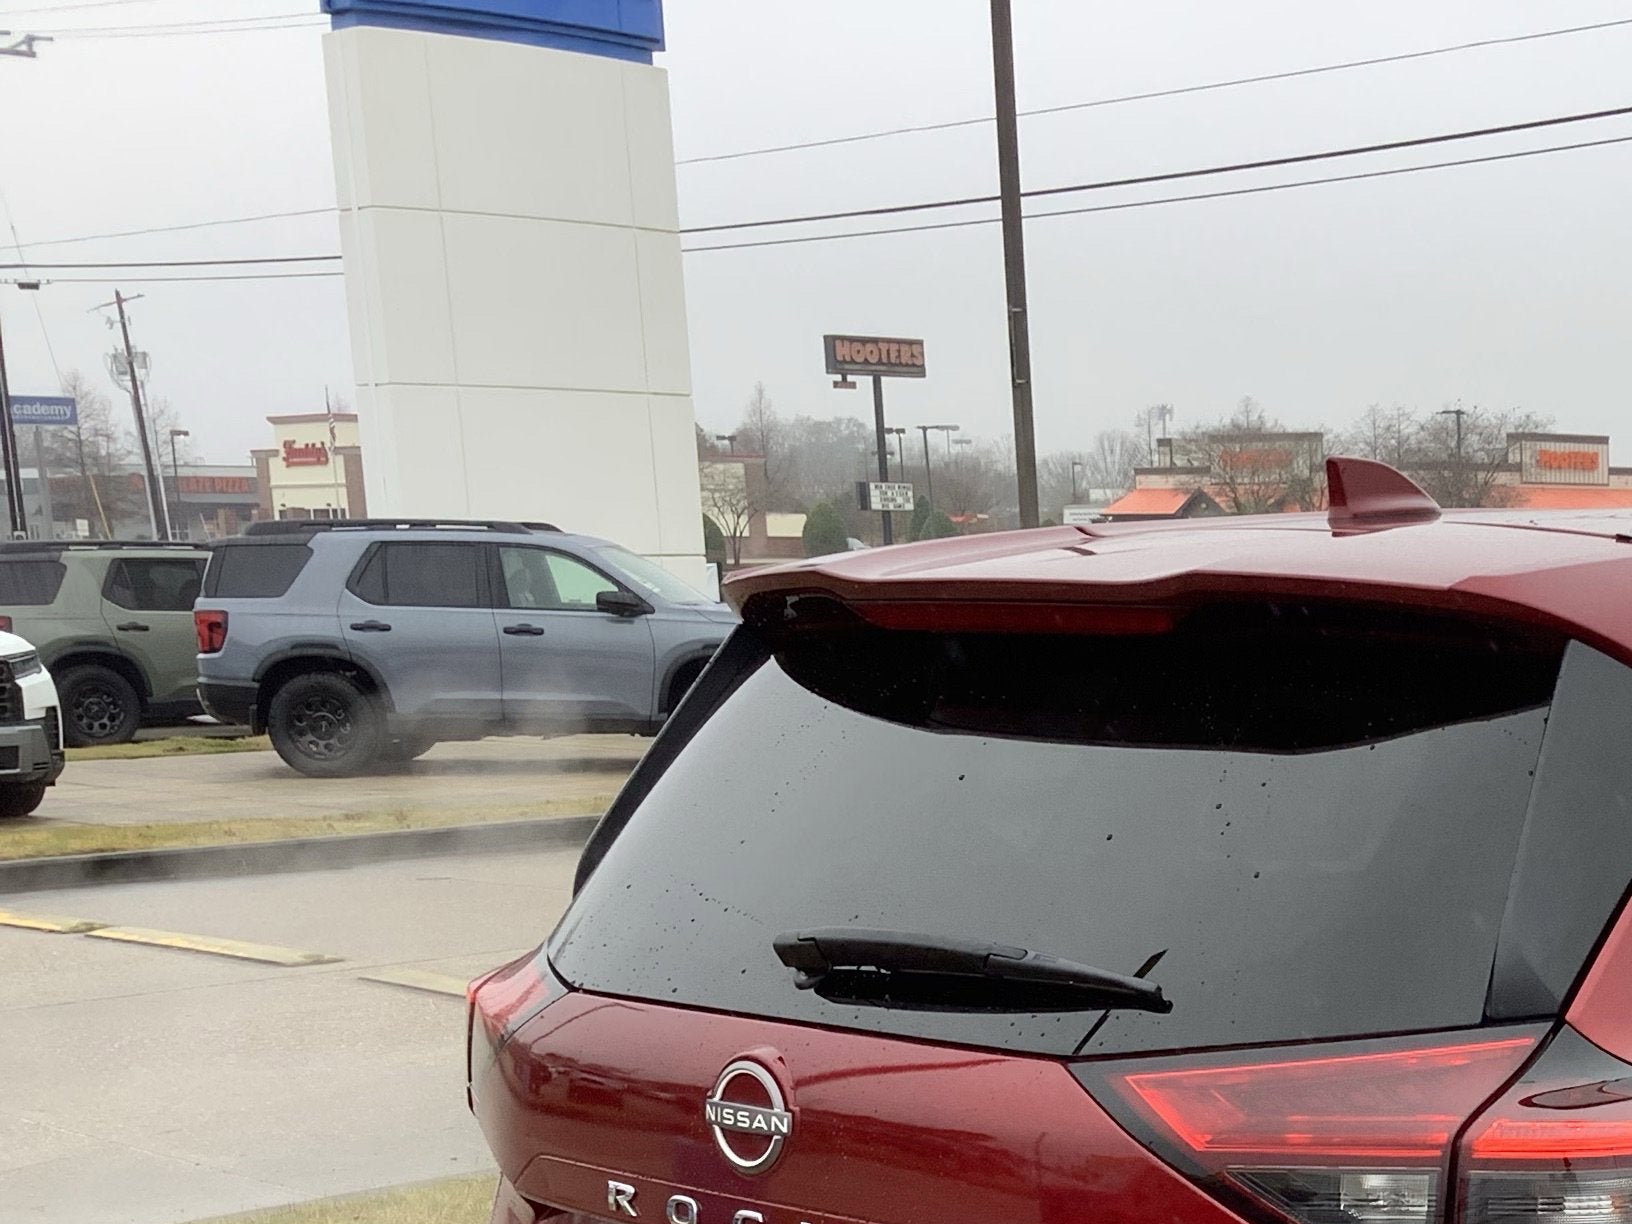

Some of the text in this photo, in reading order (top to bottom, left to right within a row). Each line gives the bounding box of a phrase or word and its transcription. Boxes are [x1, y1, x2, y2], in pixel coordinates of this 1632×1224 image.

[834, 339, 924, 366] HOOTERS
[13, 401, 72, 420] cademy
[706, 1106, 788, 1133] NISSAN
